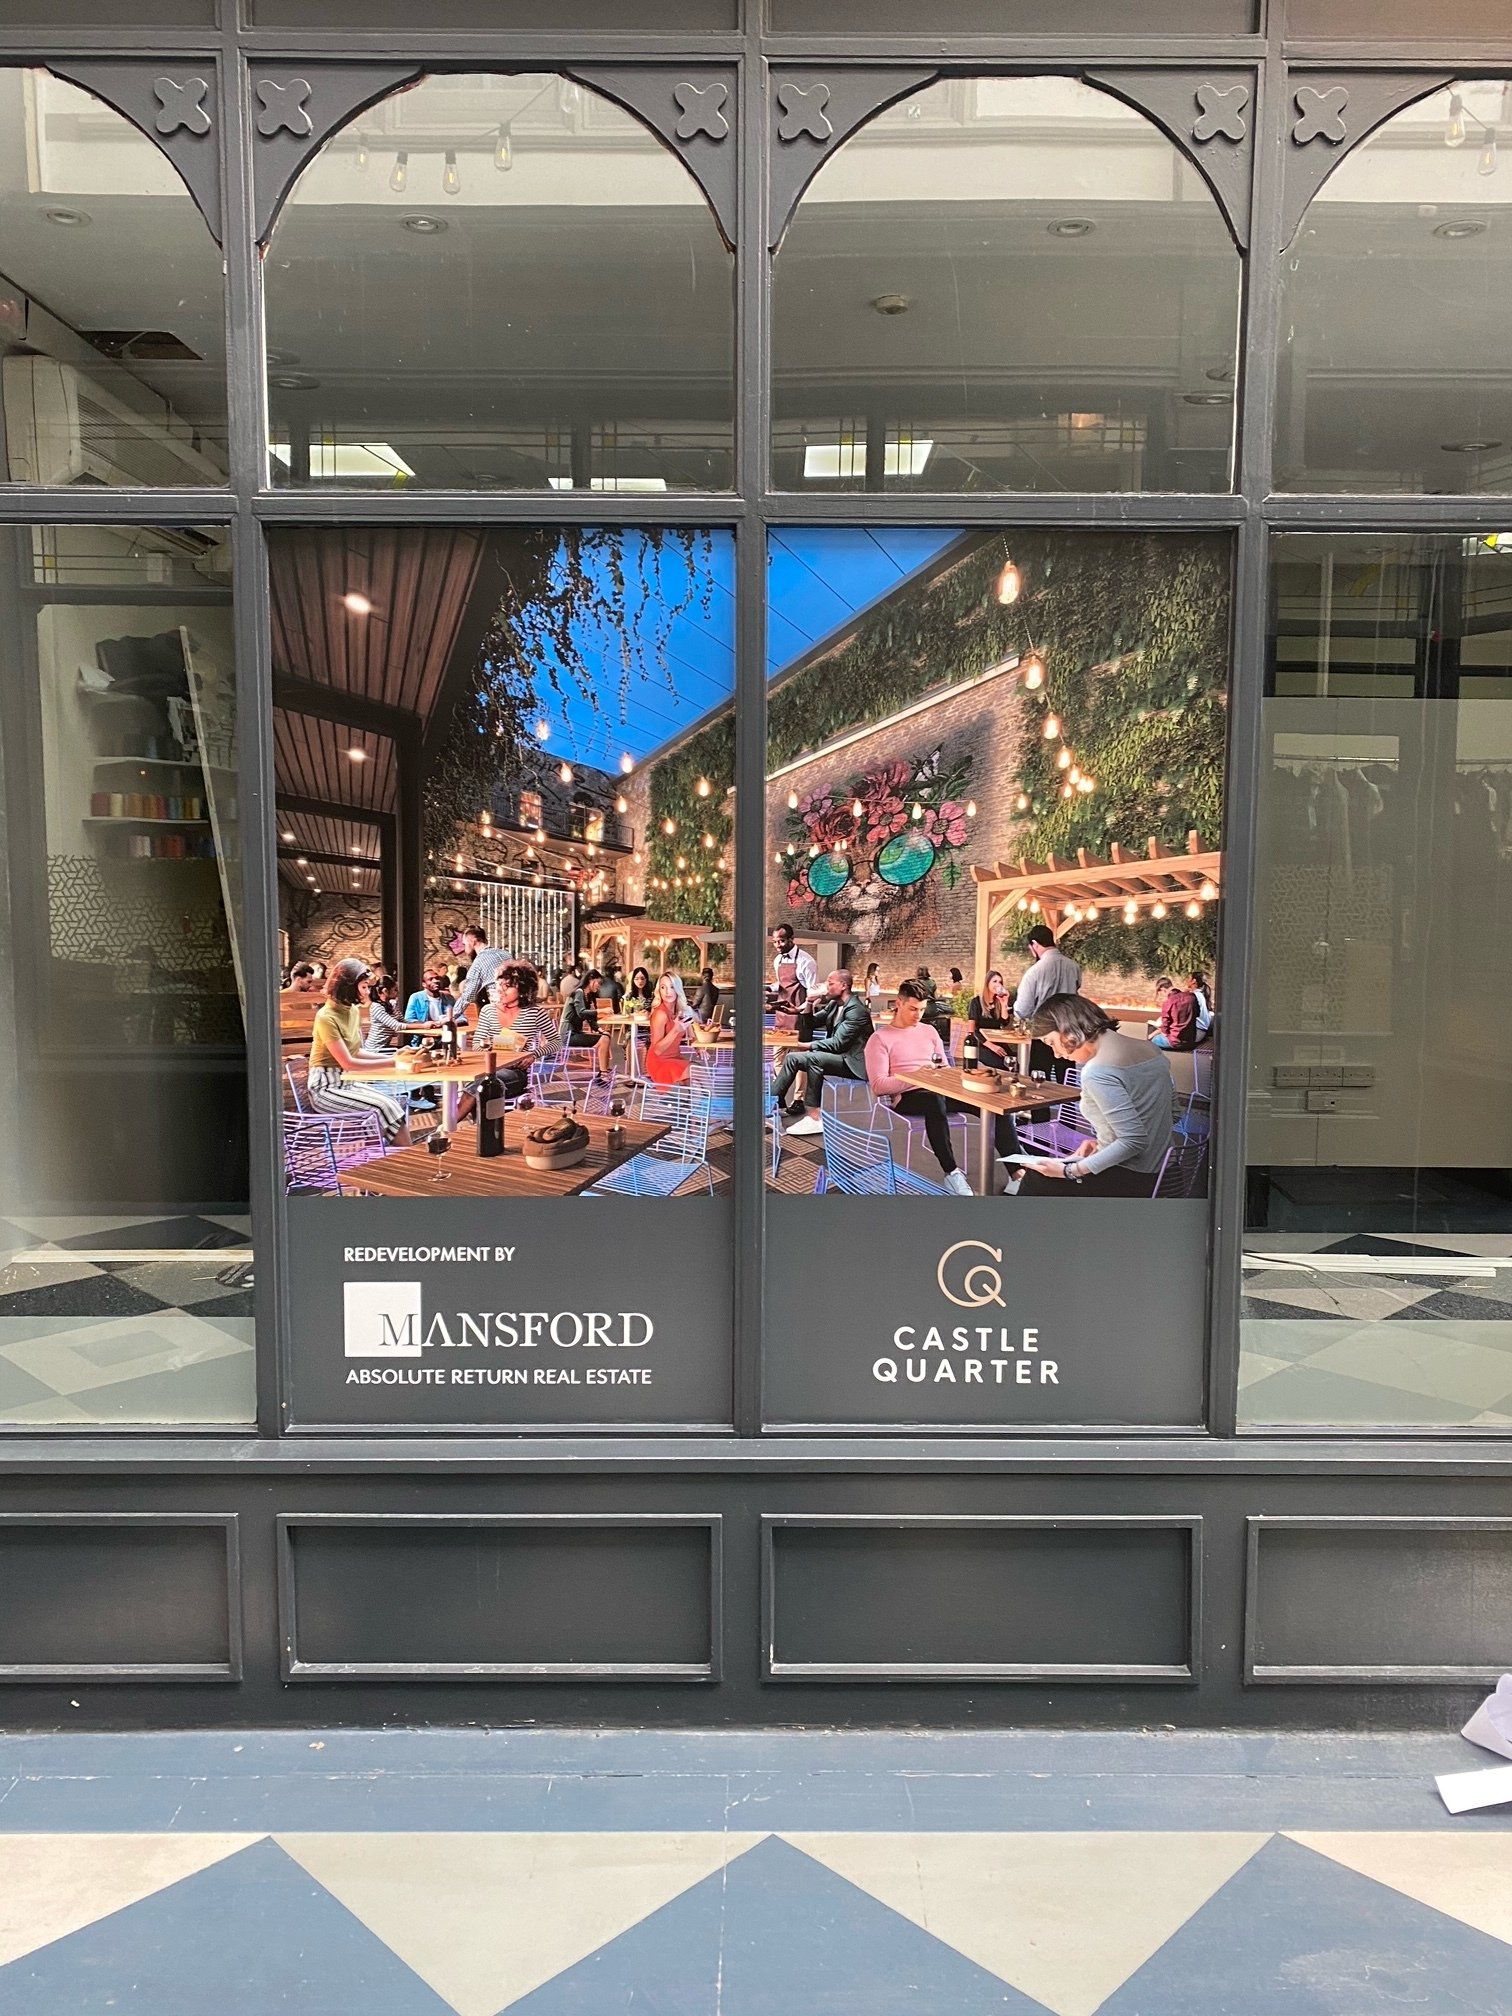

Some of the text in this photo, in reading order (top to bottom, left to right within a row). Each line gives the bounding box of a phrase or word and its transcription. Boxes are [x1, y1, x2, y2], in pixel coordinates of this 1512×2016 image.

[343, 1246, 516, 1263] REDEVELOPMENT BY
[377, 1311, 655, 1348] MANSFORD
[893, 1325, 1039, 1353] CASTLE
[345, 1368, 653, 1385] ABSOLUTE RETURN REAL ESTATE
[872, 1357, 1060, 1385] QUARTER
